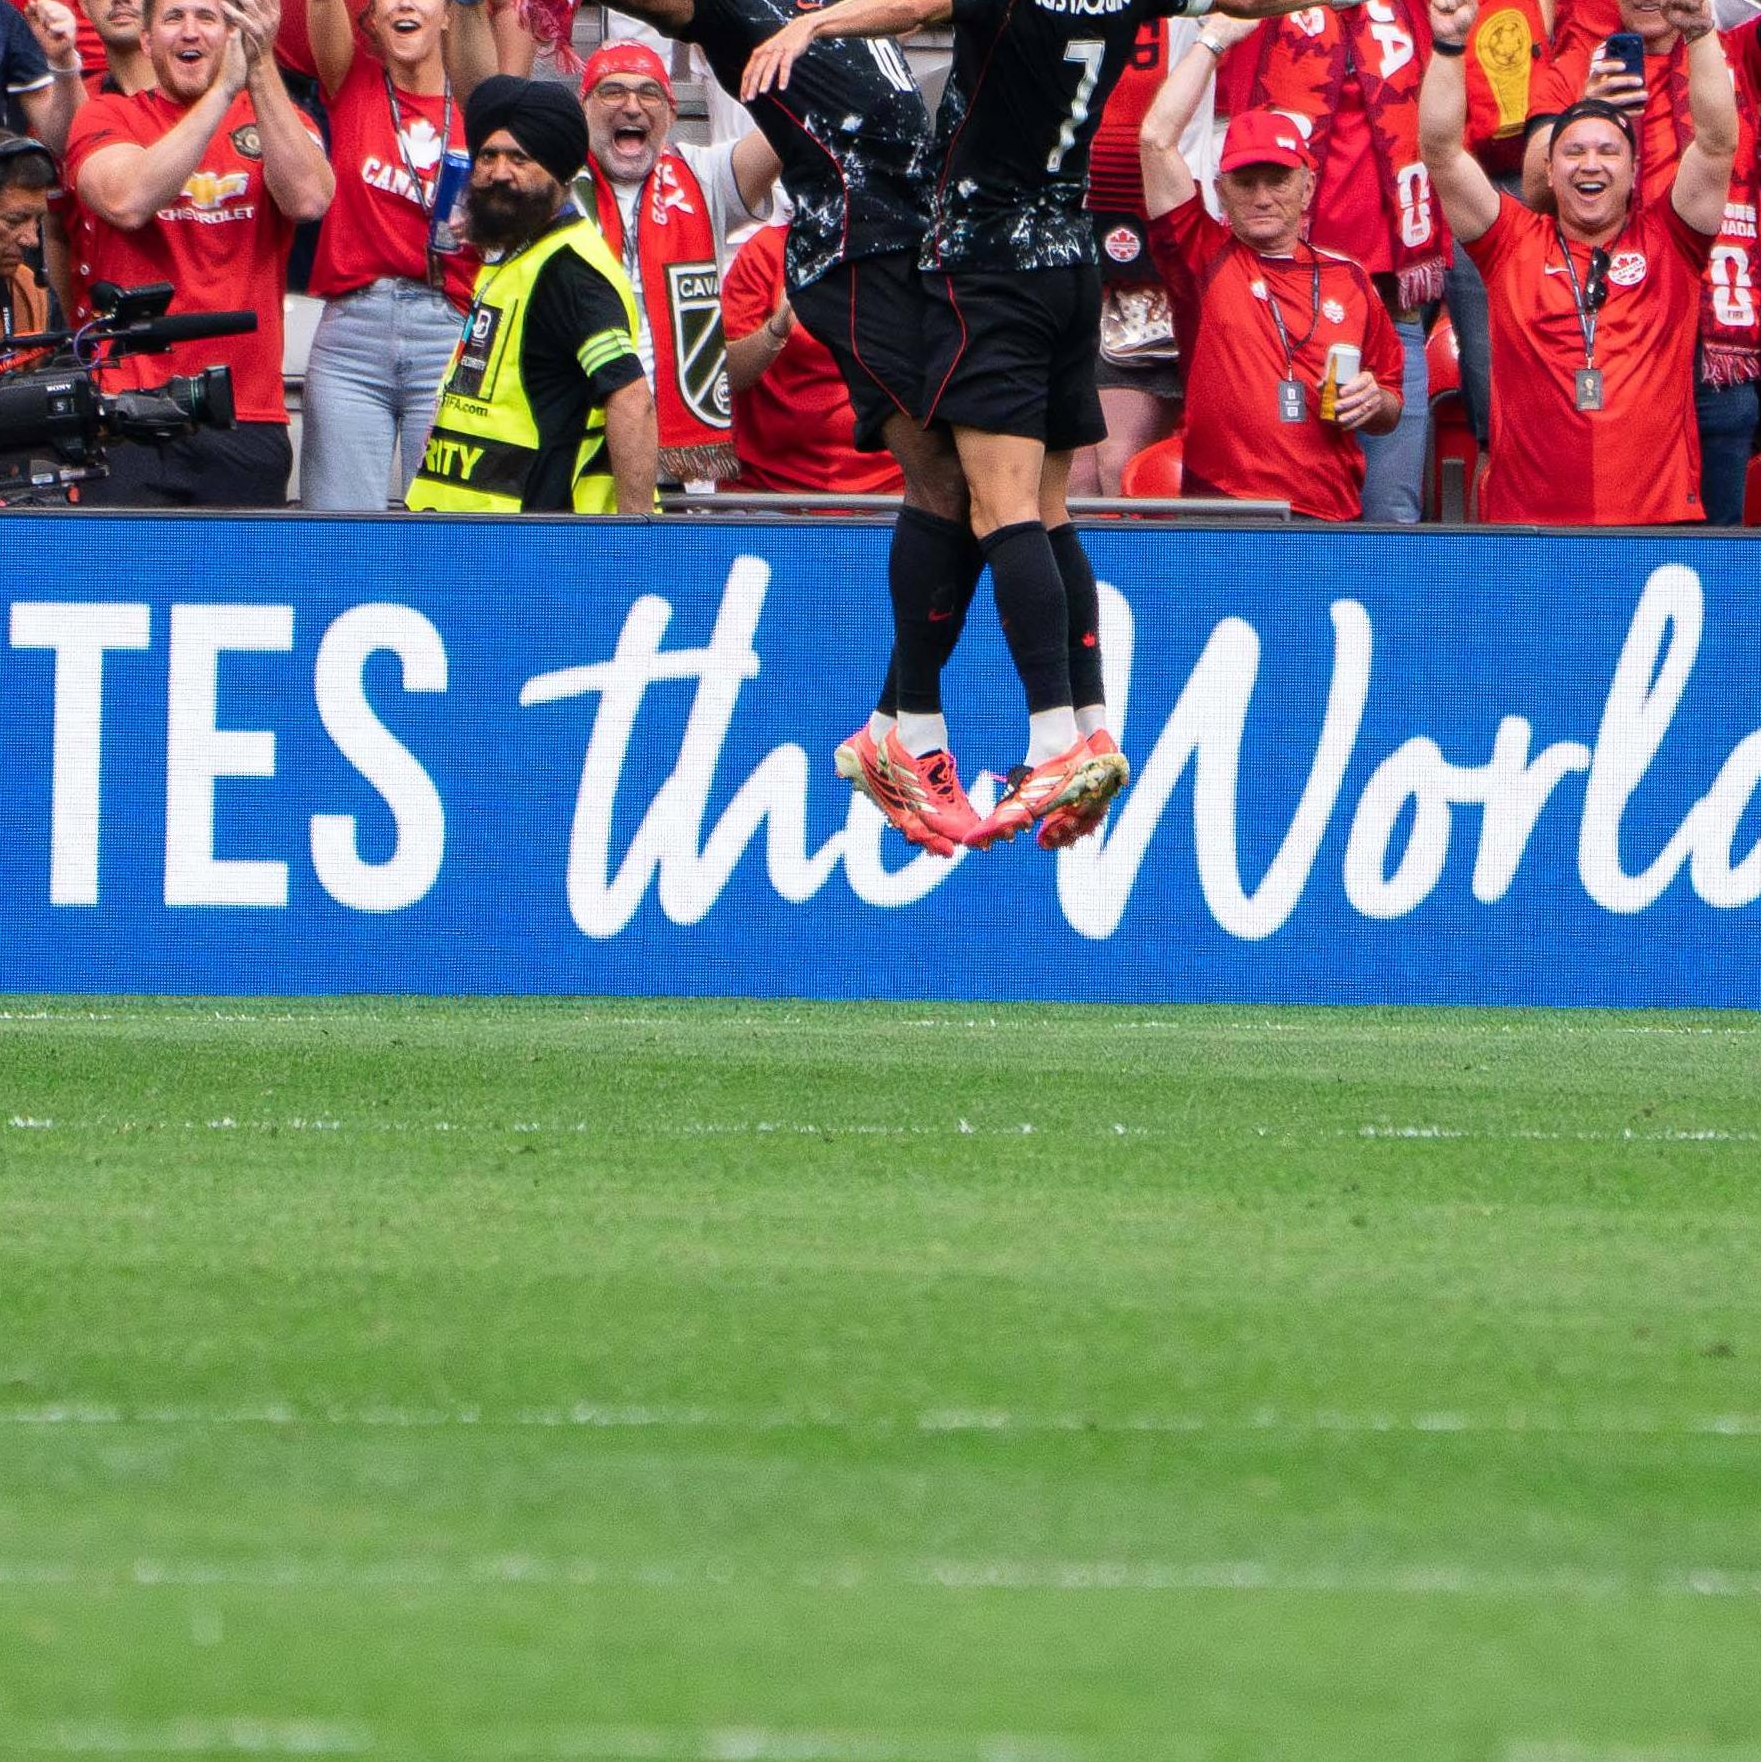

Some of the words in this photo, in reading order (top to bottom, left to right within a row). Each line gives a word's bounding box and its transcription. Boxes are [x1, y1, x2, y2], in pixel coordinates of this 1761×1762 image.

[1046, 39, 1106, 172] 7
[47, 384, 71, 392] SONY
[443, 395, 489, 418] IFA.com
